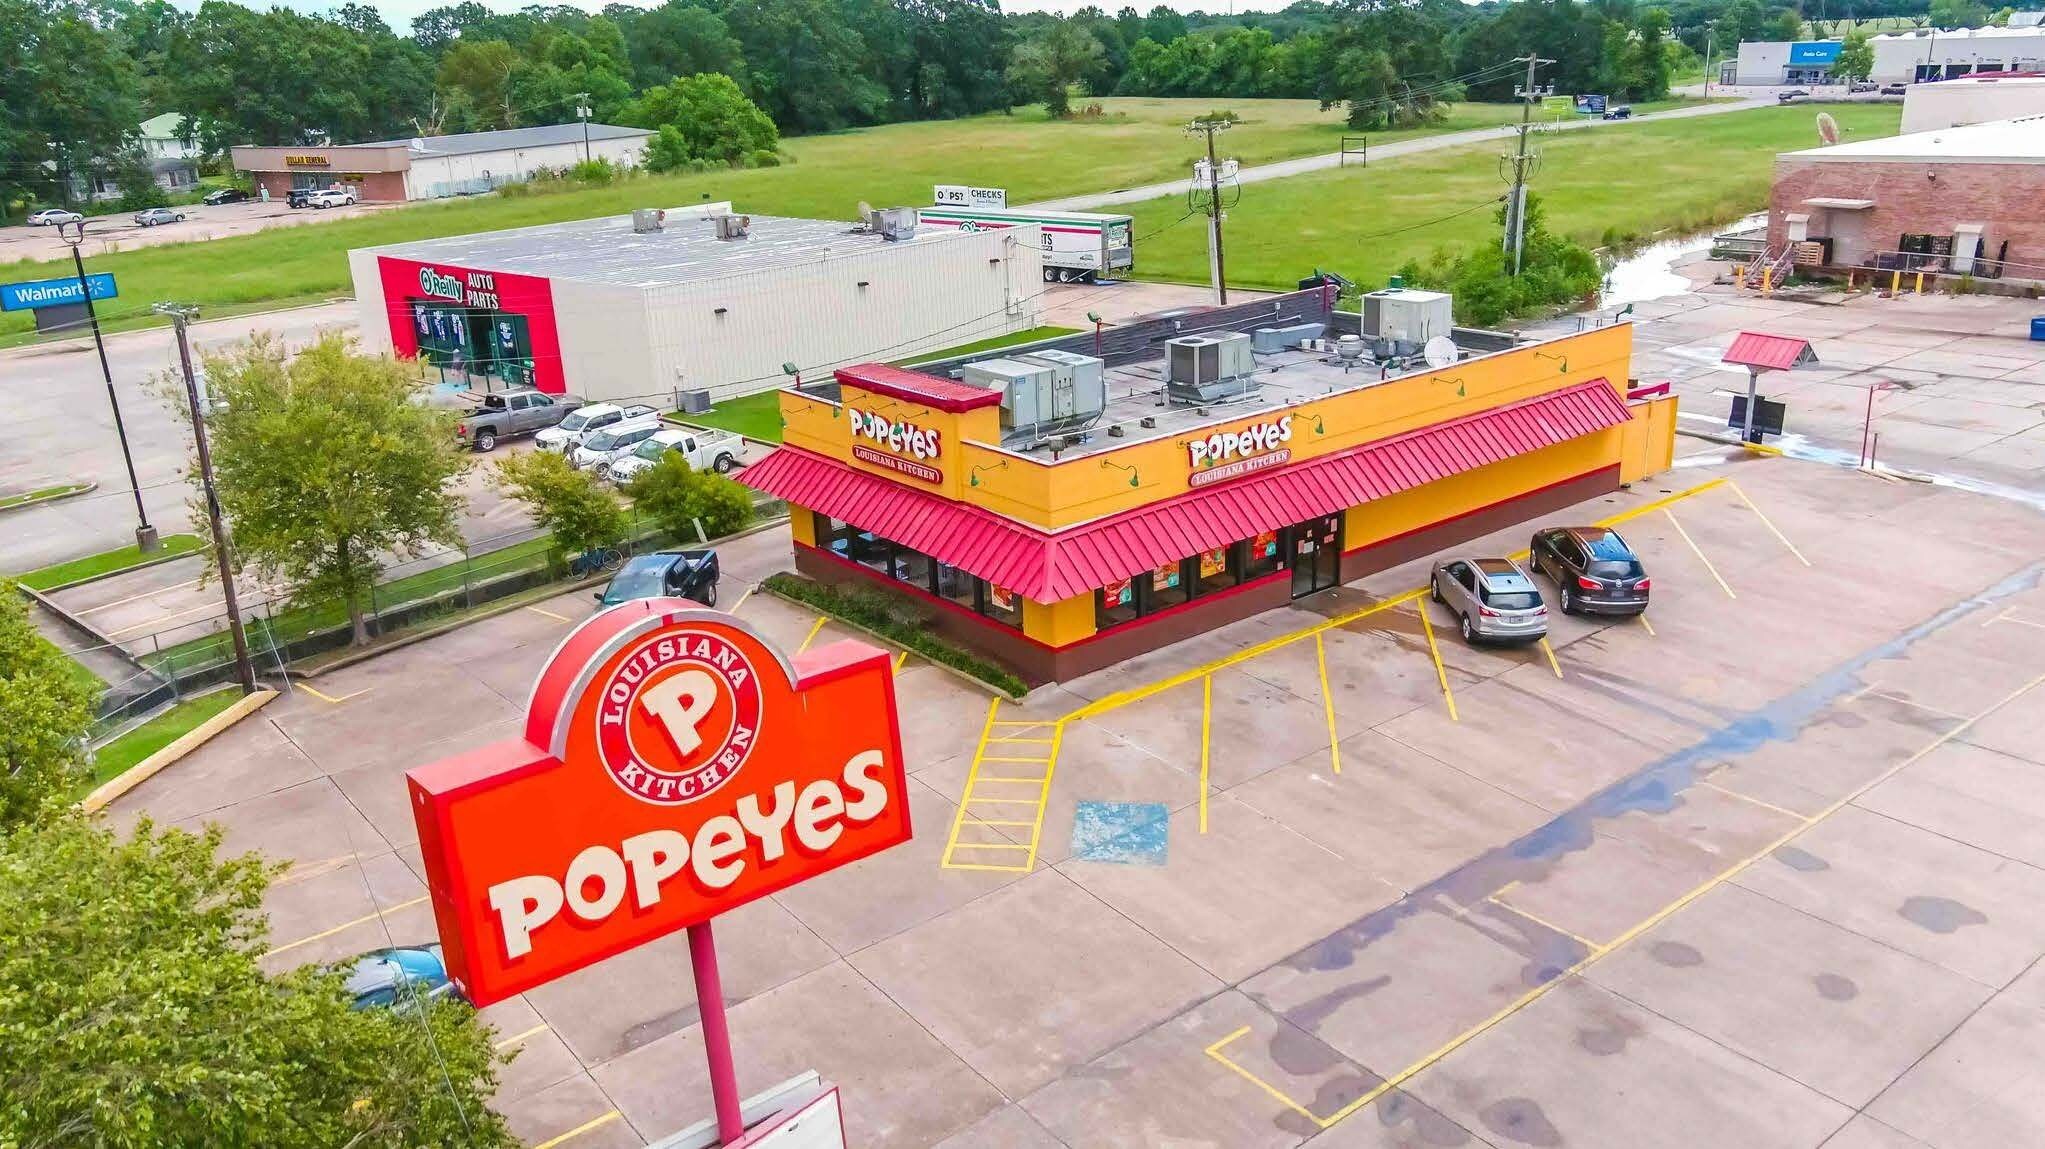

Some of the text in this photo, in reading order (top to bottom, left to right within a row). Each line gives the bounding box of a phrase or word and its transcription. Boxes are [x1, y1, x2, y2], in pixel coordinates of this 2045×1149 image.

[970, 189, 1002, 199] CHECKS
[15, 283, 85, 303] Walmart
[420, 267, 463, 303] O'Reilly
[467, 272, 494, 290] AUTO
[467, 290, 499, 310] PARTS
[855, 448, 936, 481] LOUISIANA KITCHEN
[1246, 452, 1288, 471] KITCHEN
[603, 637, 749, 727] LOUISIANA
[640, 670, 718, 757] P
[618, 723, 753, 799] KITCHEN
